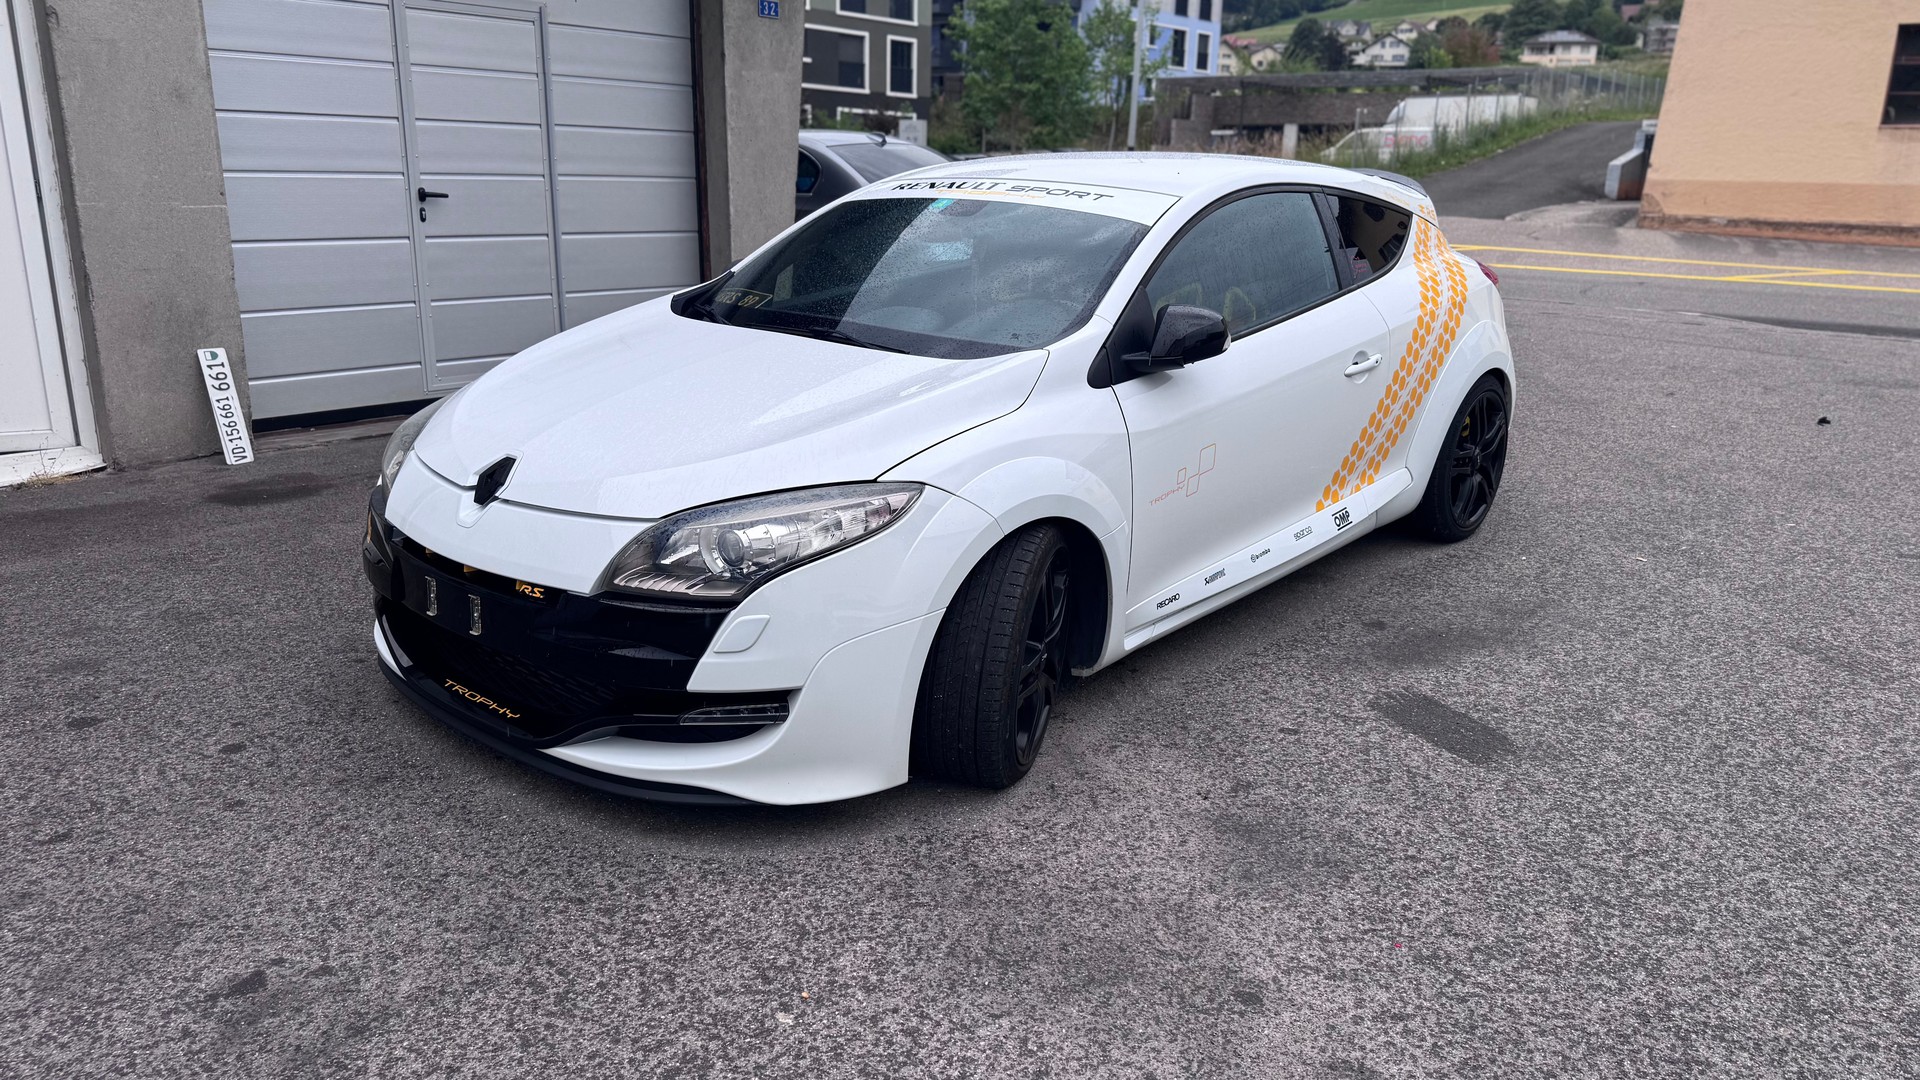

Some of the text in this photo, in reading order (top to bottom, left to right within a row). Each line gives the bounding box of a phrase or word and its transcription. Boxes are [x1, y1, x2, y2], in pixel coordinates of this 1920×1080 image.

[763, 1, 776, 15] 32
[892, 181, 1114, 201] RENAULT SPORT
[1149, 484, 1185, 506] TROPHY
[1334, 510, 1350, 528] OMP
[519, 584, 545, 598] R.S.
[1156, 593, 1180, 610] RECARO
[444, 678, 520, 718] TROPHY
